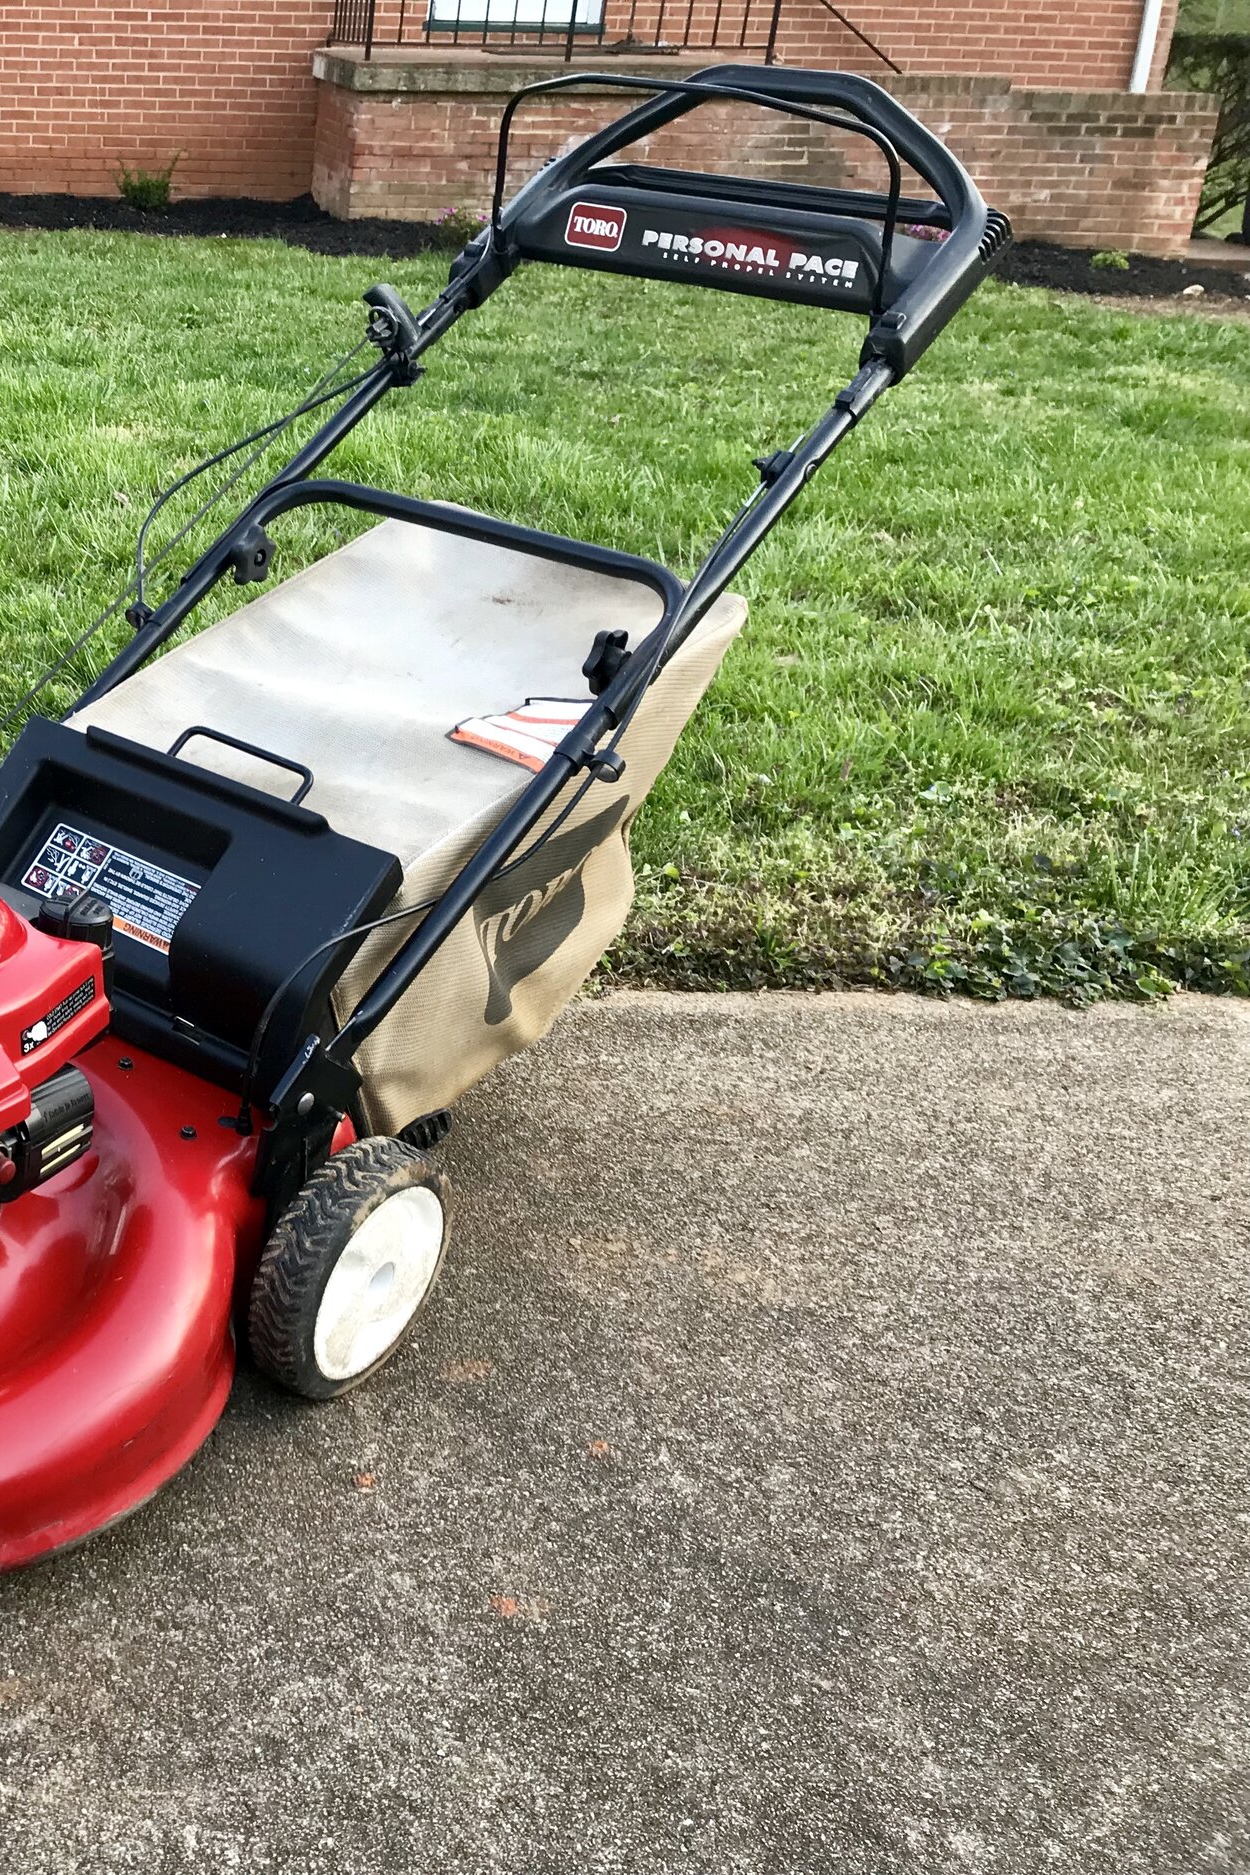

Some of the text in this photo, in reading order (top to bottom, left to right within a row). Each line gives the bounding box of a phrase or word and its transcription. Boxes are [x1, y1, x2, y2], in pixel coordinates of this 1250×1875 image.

[573, 216, 618, 238] TORO
[642, 230, 859, 279] PERSONAL PACE
[663, 252, 853, 288] SELF PROPEL SYSTEM
[124, 923, 166, 948] WARNING
